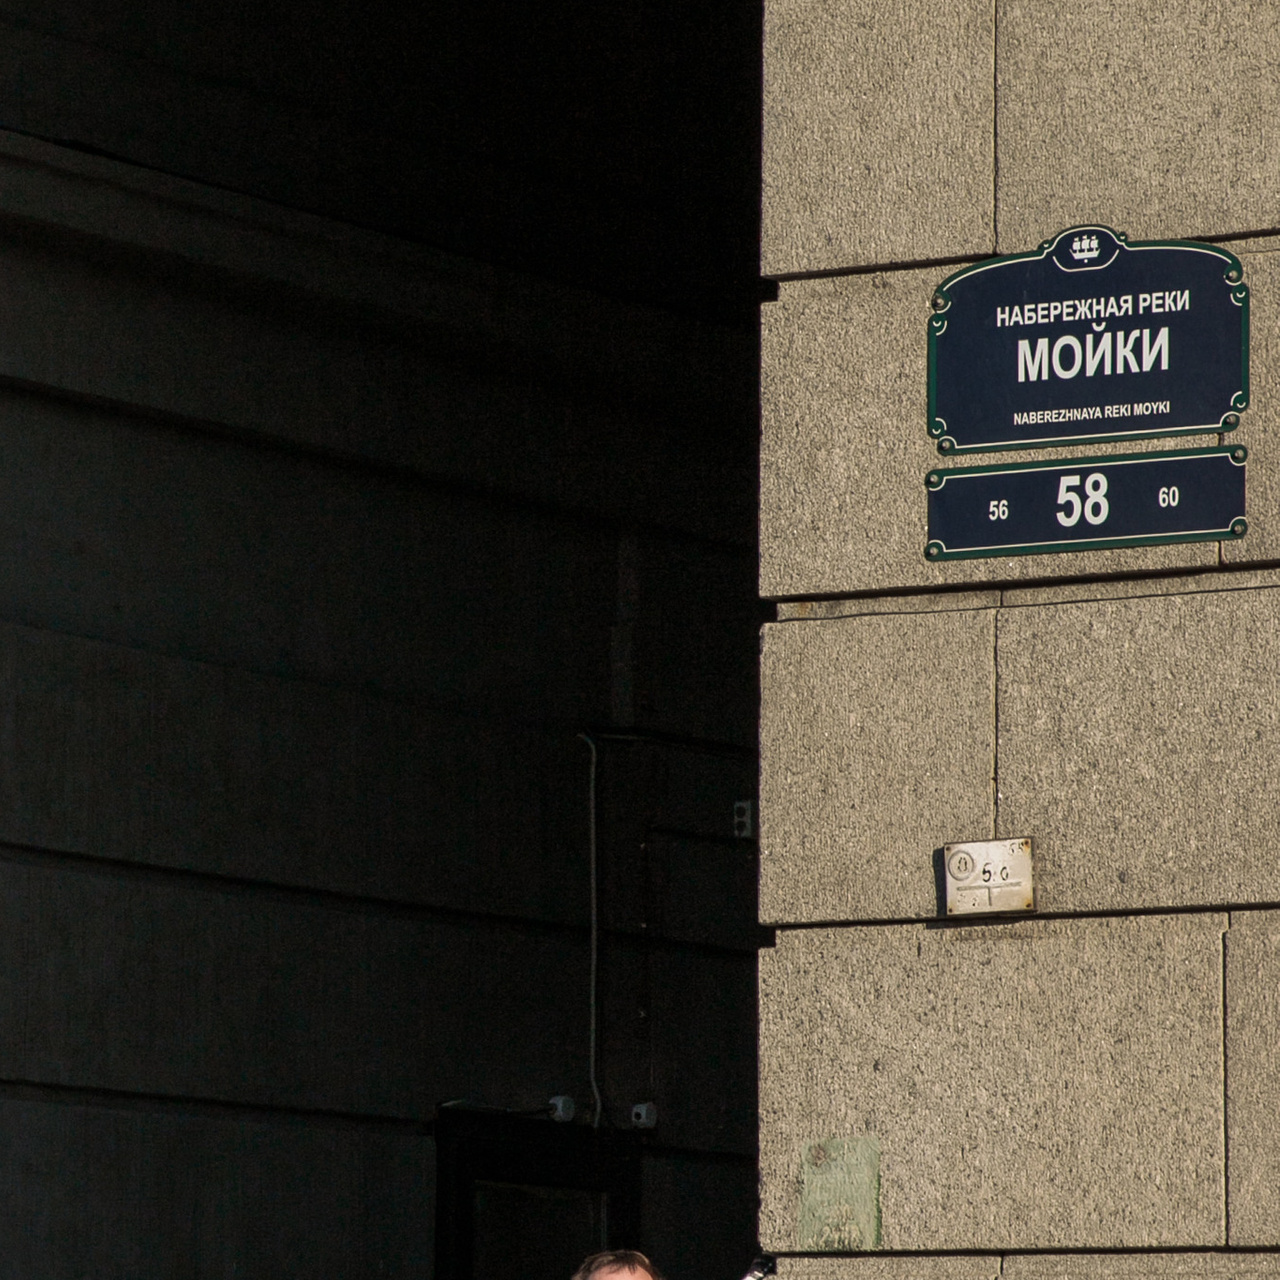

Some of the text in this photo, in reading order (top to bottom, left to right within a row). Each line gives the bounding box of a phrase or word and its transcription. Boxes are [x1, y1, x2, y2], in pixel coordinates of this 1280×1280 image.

[995, 289, 1191, 328] НАБЕРЕЖНАЯ РЕКИ
[1017, 321, 1170, 383] МОЙКИ
[1013, 400, 1171, 426] NABEREZHNAYA REKI MOYKI
[988, 499, 1009, 521] 56
[1055, 472, 1110, 528] 58
[1158, 486, 1180, 508] 60
